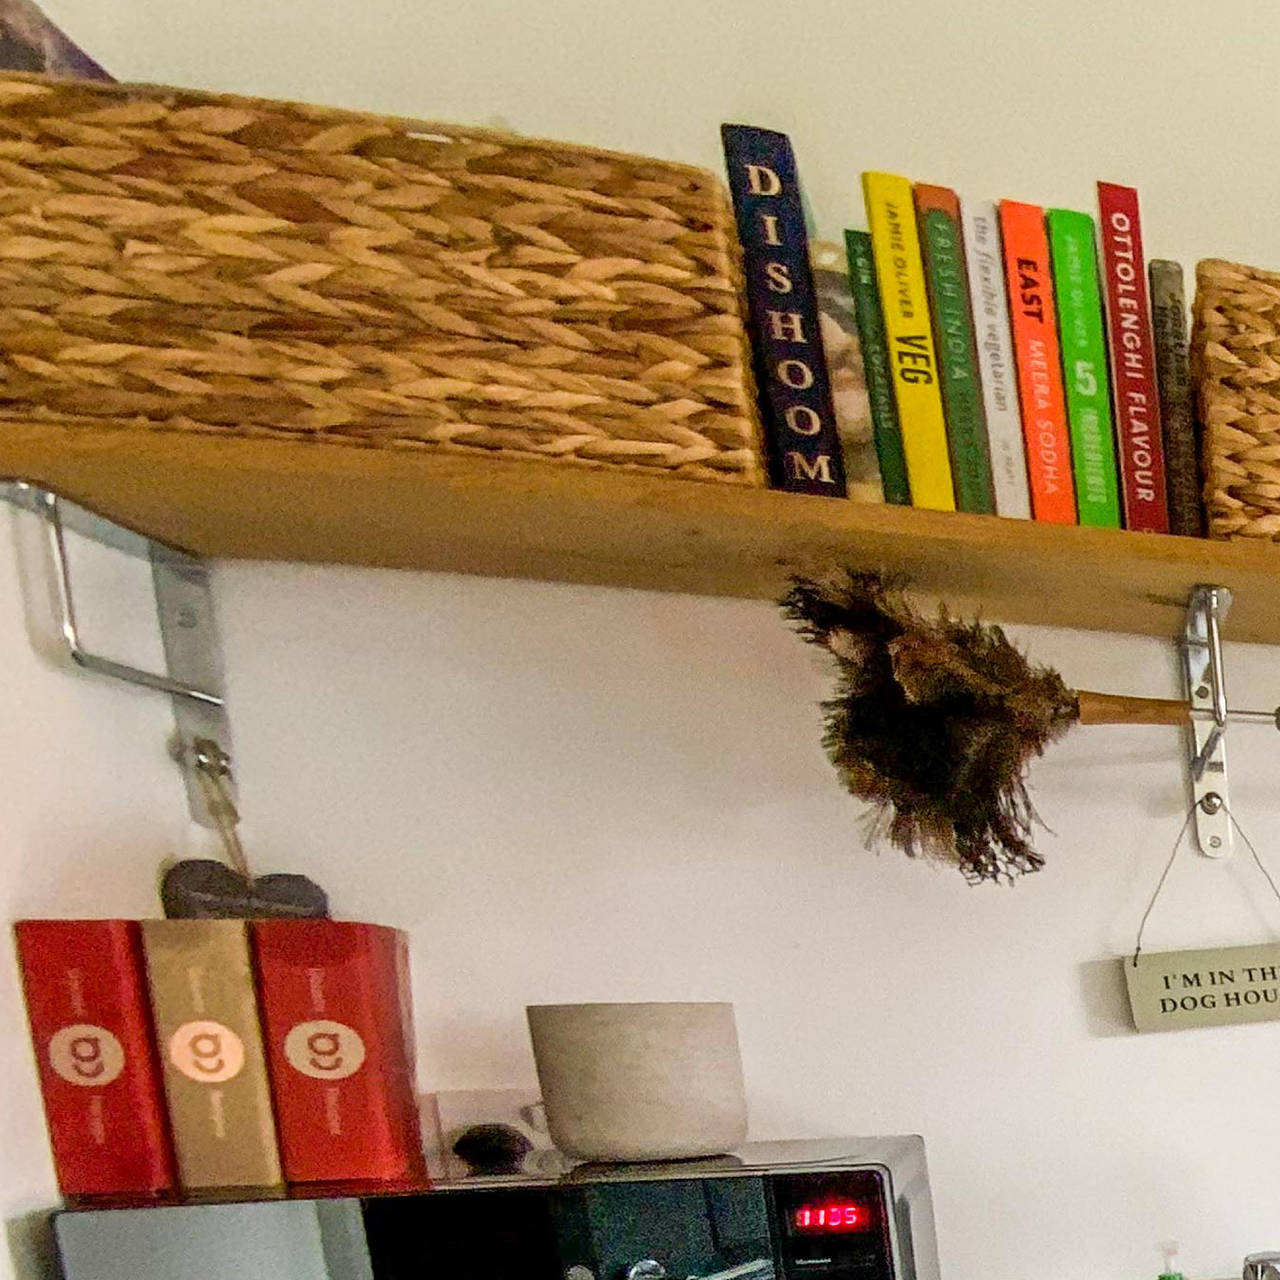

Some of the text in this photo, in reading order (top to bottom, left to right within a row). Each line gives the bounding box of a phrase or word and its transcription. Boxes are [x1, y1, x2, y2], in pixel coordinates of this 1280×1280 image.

[893, 257, 914, 318] OLIVER
[744, 164, 836, 484] DISHOOM
[943, 310, 970, 380] INDIA
[895, 334, 933, 385] VEG
[1016, 257, 1059, 494] EAST MEERA SODHA
[1074, 360, 1097, 396] 5
[1111, 211, 1155, 502] OTTOLENGHI FLAVOUR
[1162, 972, 1201, 990] I'M
[1208, 970, 1236, 986] IN
[1160, 993, 1217, 1014] DOG
[71, 1037, 104, 1078] g
[188, 1033, 224, 1074] g
[307, 1032, 343, 1071] g
